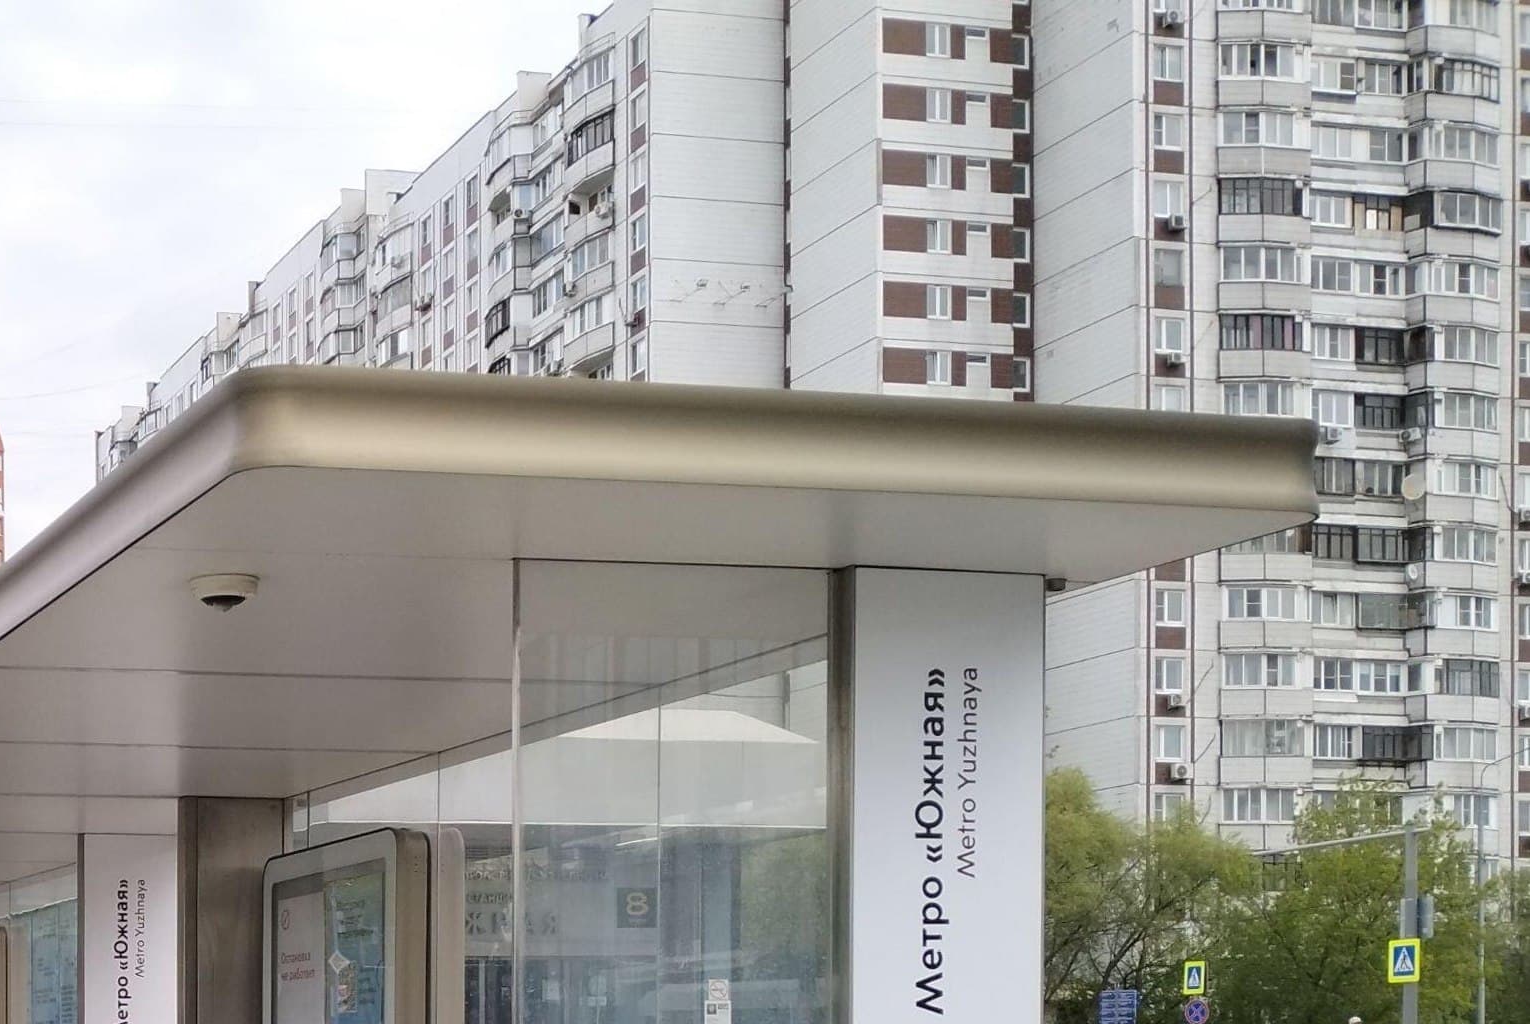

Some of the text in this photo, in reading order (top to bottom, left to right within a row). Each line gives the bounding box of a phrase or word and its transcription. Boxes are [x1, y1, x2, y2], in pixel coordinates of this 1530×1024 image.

[956, 667, 983, 879] Metro Yuzhnaya
[914, 667, 950, 1015] Метро «Южная»
[113, 879, 129, 970] «Южная»
[134, 879, 148, 978] Metro Yuzhnaya
[626, 892, 649, 916] 8
